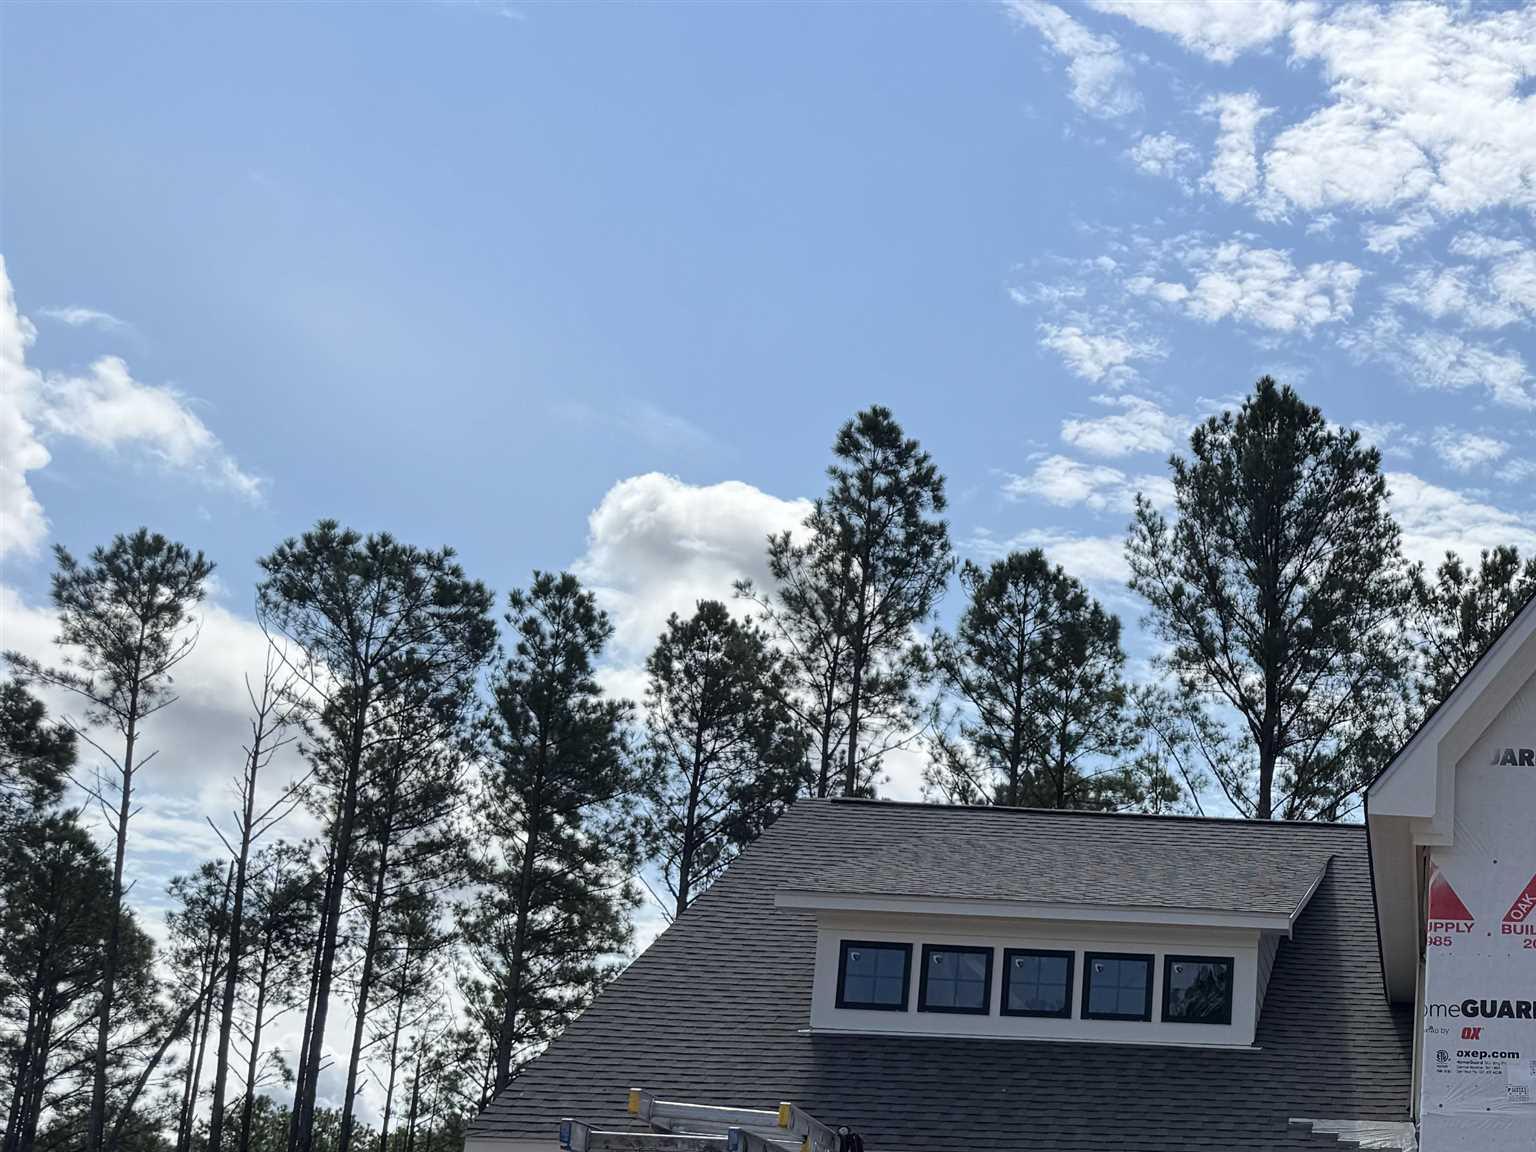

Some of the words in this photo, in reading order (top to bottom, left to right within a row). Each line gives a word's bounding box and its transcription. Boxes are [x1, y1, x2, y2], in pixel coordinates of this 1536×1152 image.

[1510, 893, 1536, 920] OAK
[1462, 1027, 1481, 1040] OX
[1457, 1050, 1520, 1059] oxep.com
